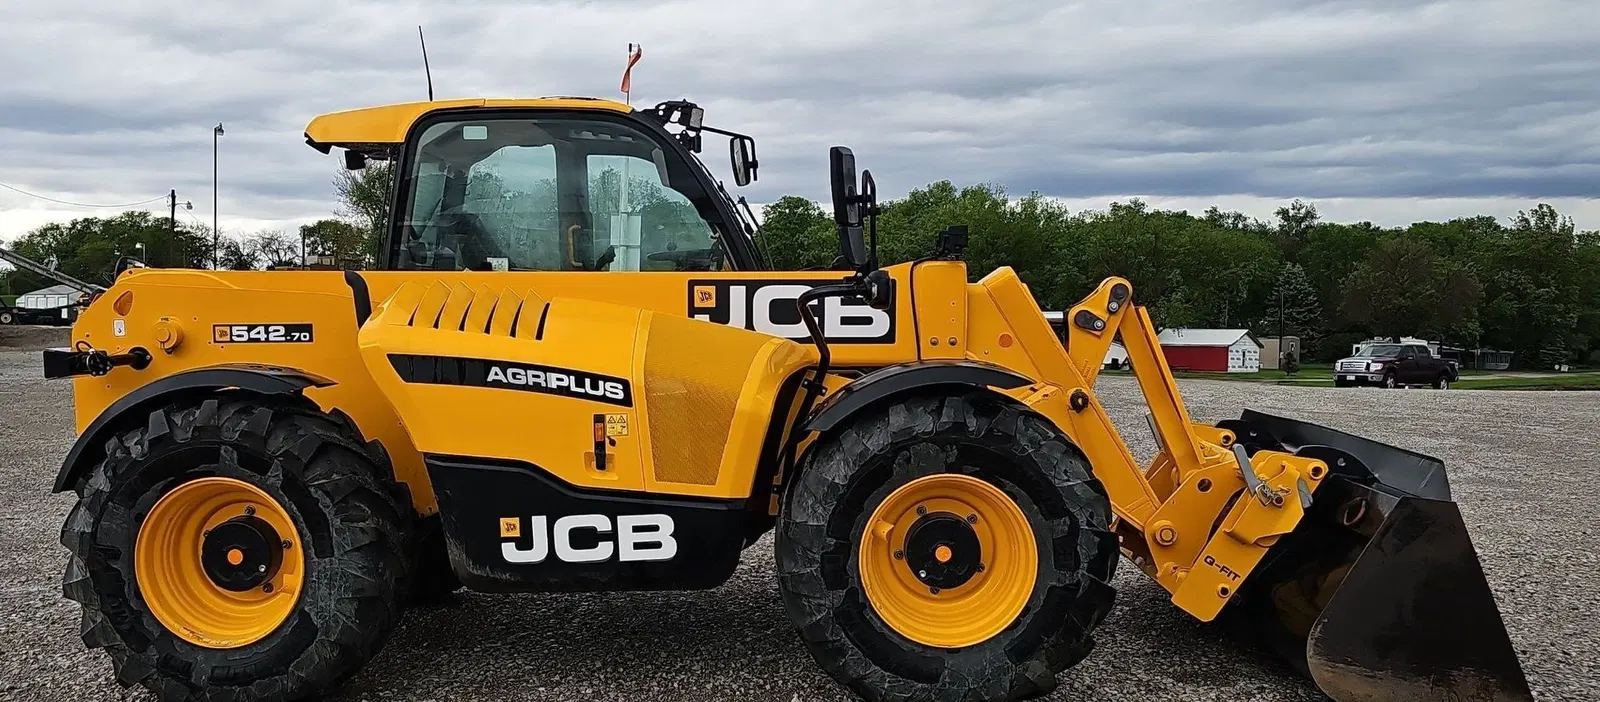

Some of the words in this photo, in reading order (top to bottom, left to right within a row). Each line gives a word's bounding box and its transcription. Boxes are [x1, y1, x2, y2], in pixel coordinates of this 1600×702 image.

[694, 285, 891, 338] JCB
[486, 366, 625, 400] AGRIPLUS
[501, 514, 678, 563] JCB
[1204, 555, 1241, 581] Q-FIT
